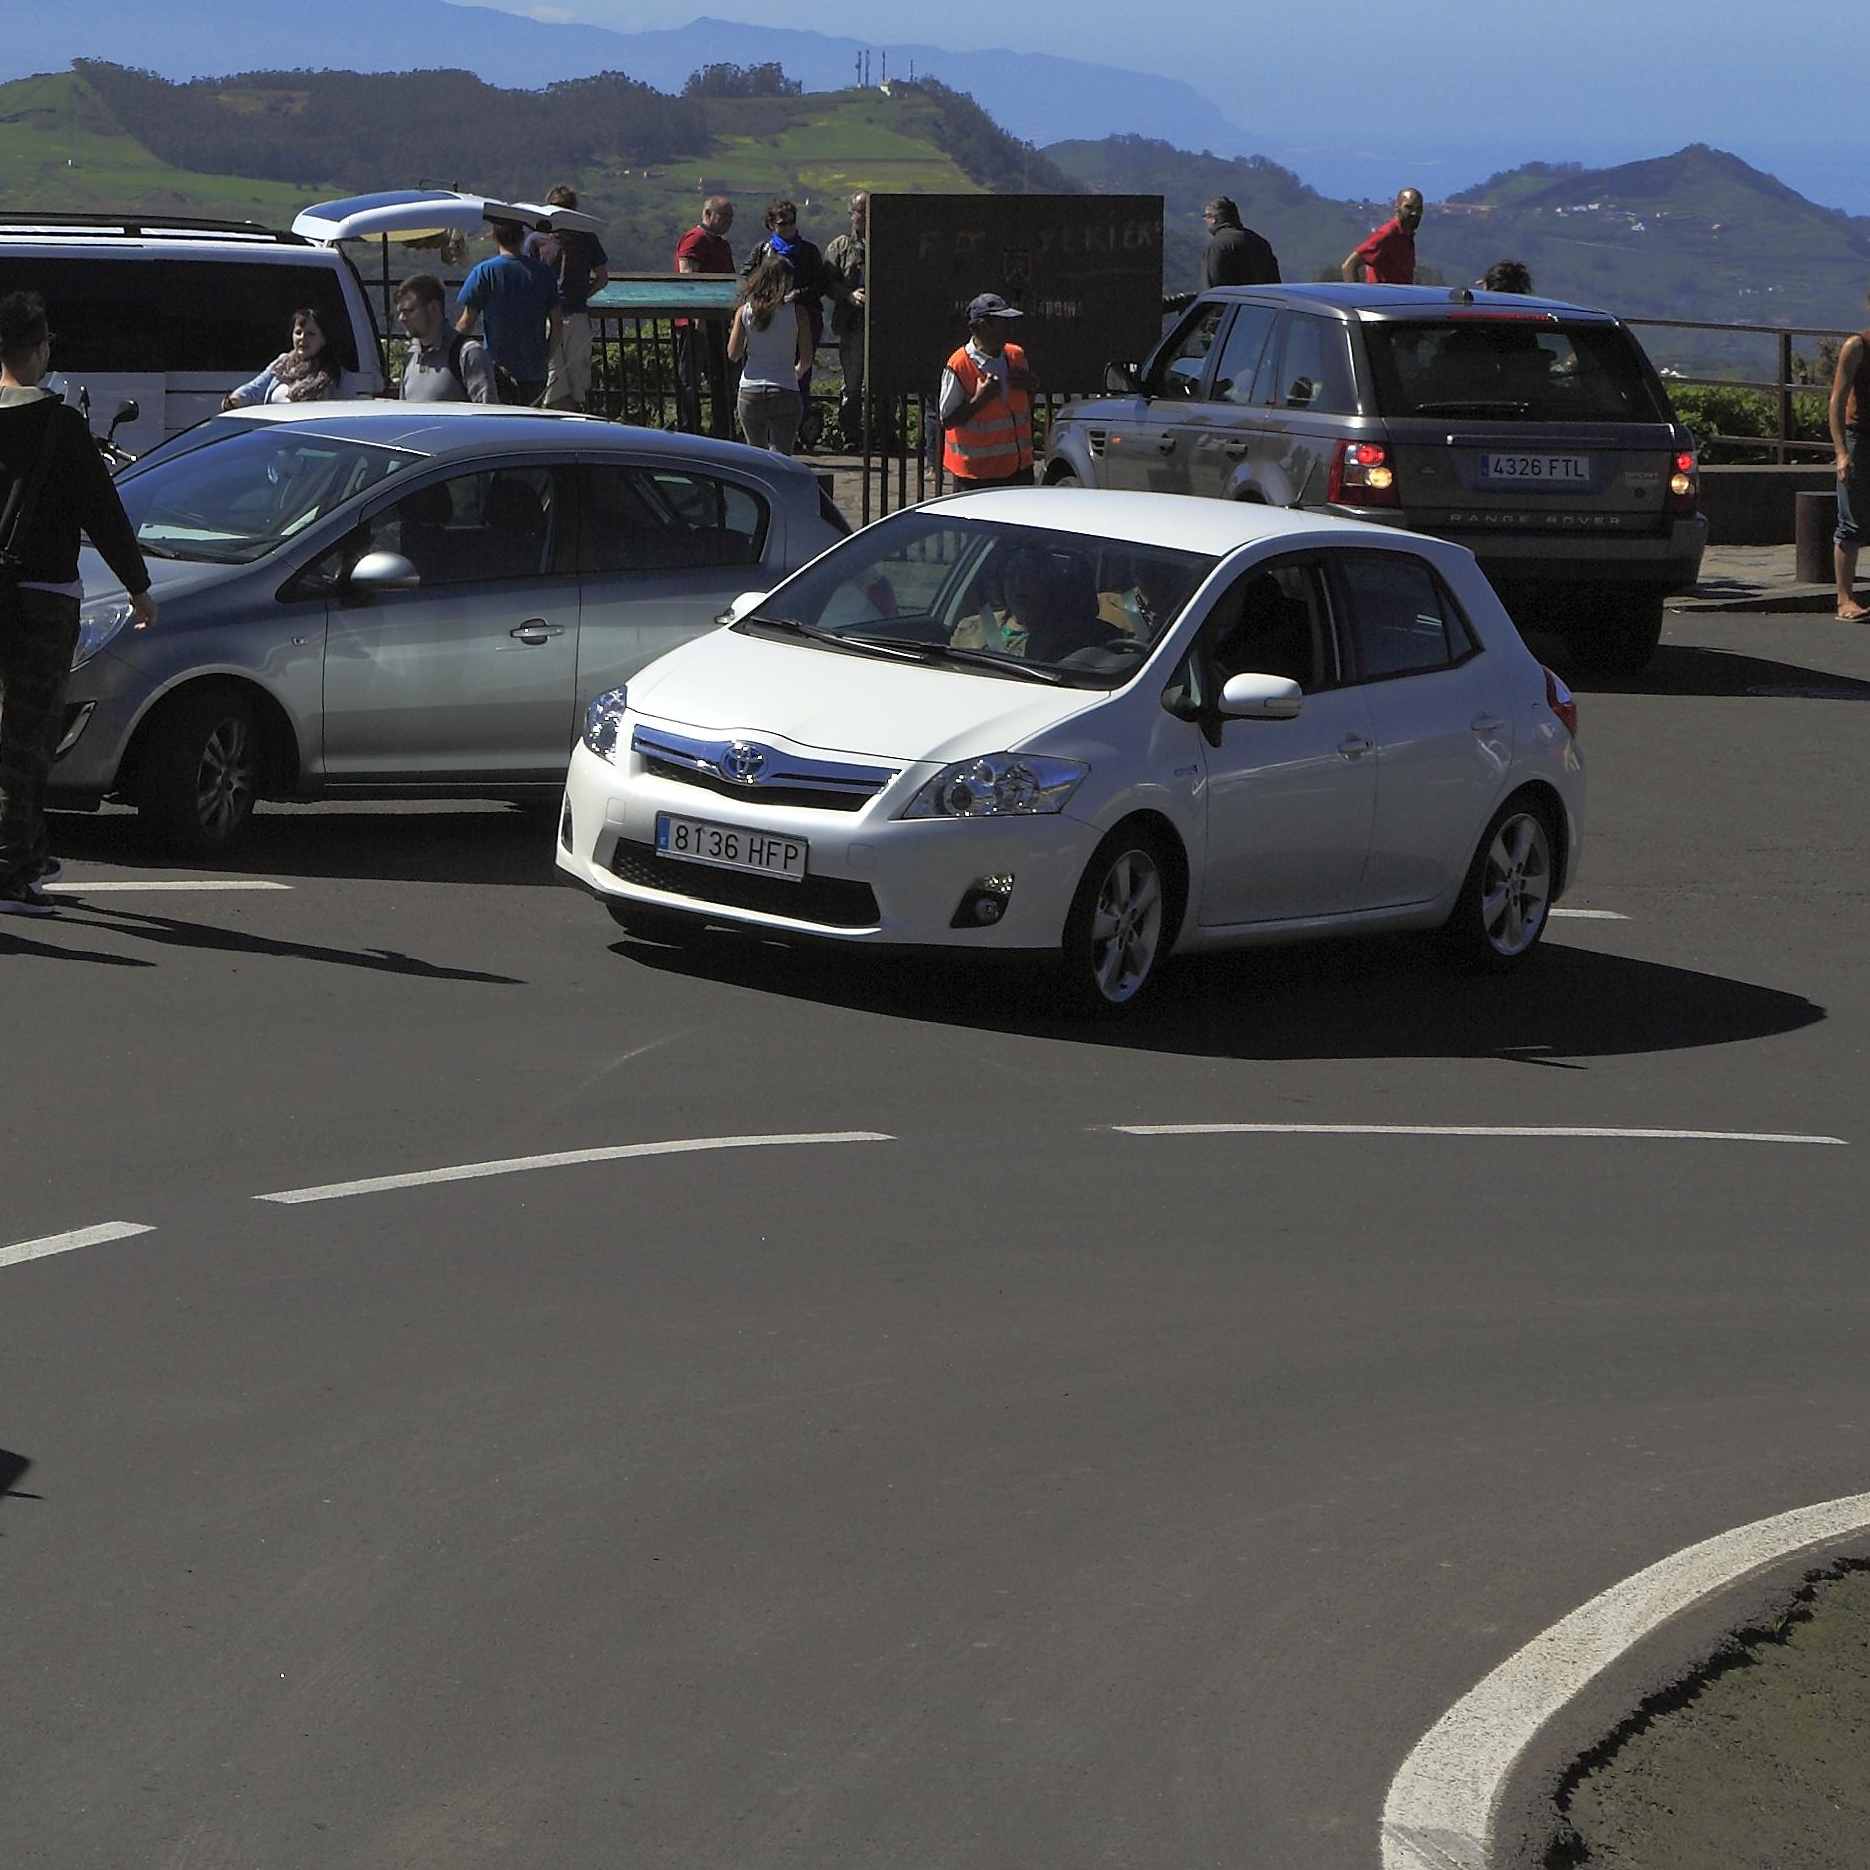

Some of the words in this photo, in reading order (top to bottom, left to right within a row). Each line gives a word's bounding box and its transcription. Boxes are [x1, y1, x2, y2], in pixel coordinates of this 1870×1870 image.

[1493, 458, 1542, 476] 4326
[1549, 459, 1584, 477] FTL
[1449, 513, 1531, 524] RANGE
[1546, 515, 1621, 525] ROVER
[675, 825, 738, 860] 8136
[748, 837, 799, 869] HFP
